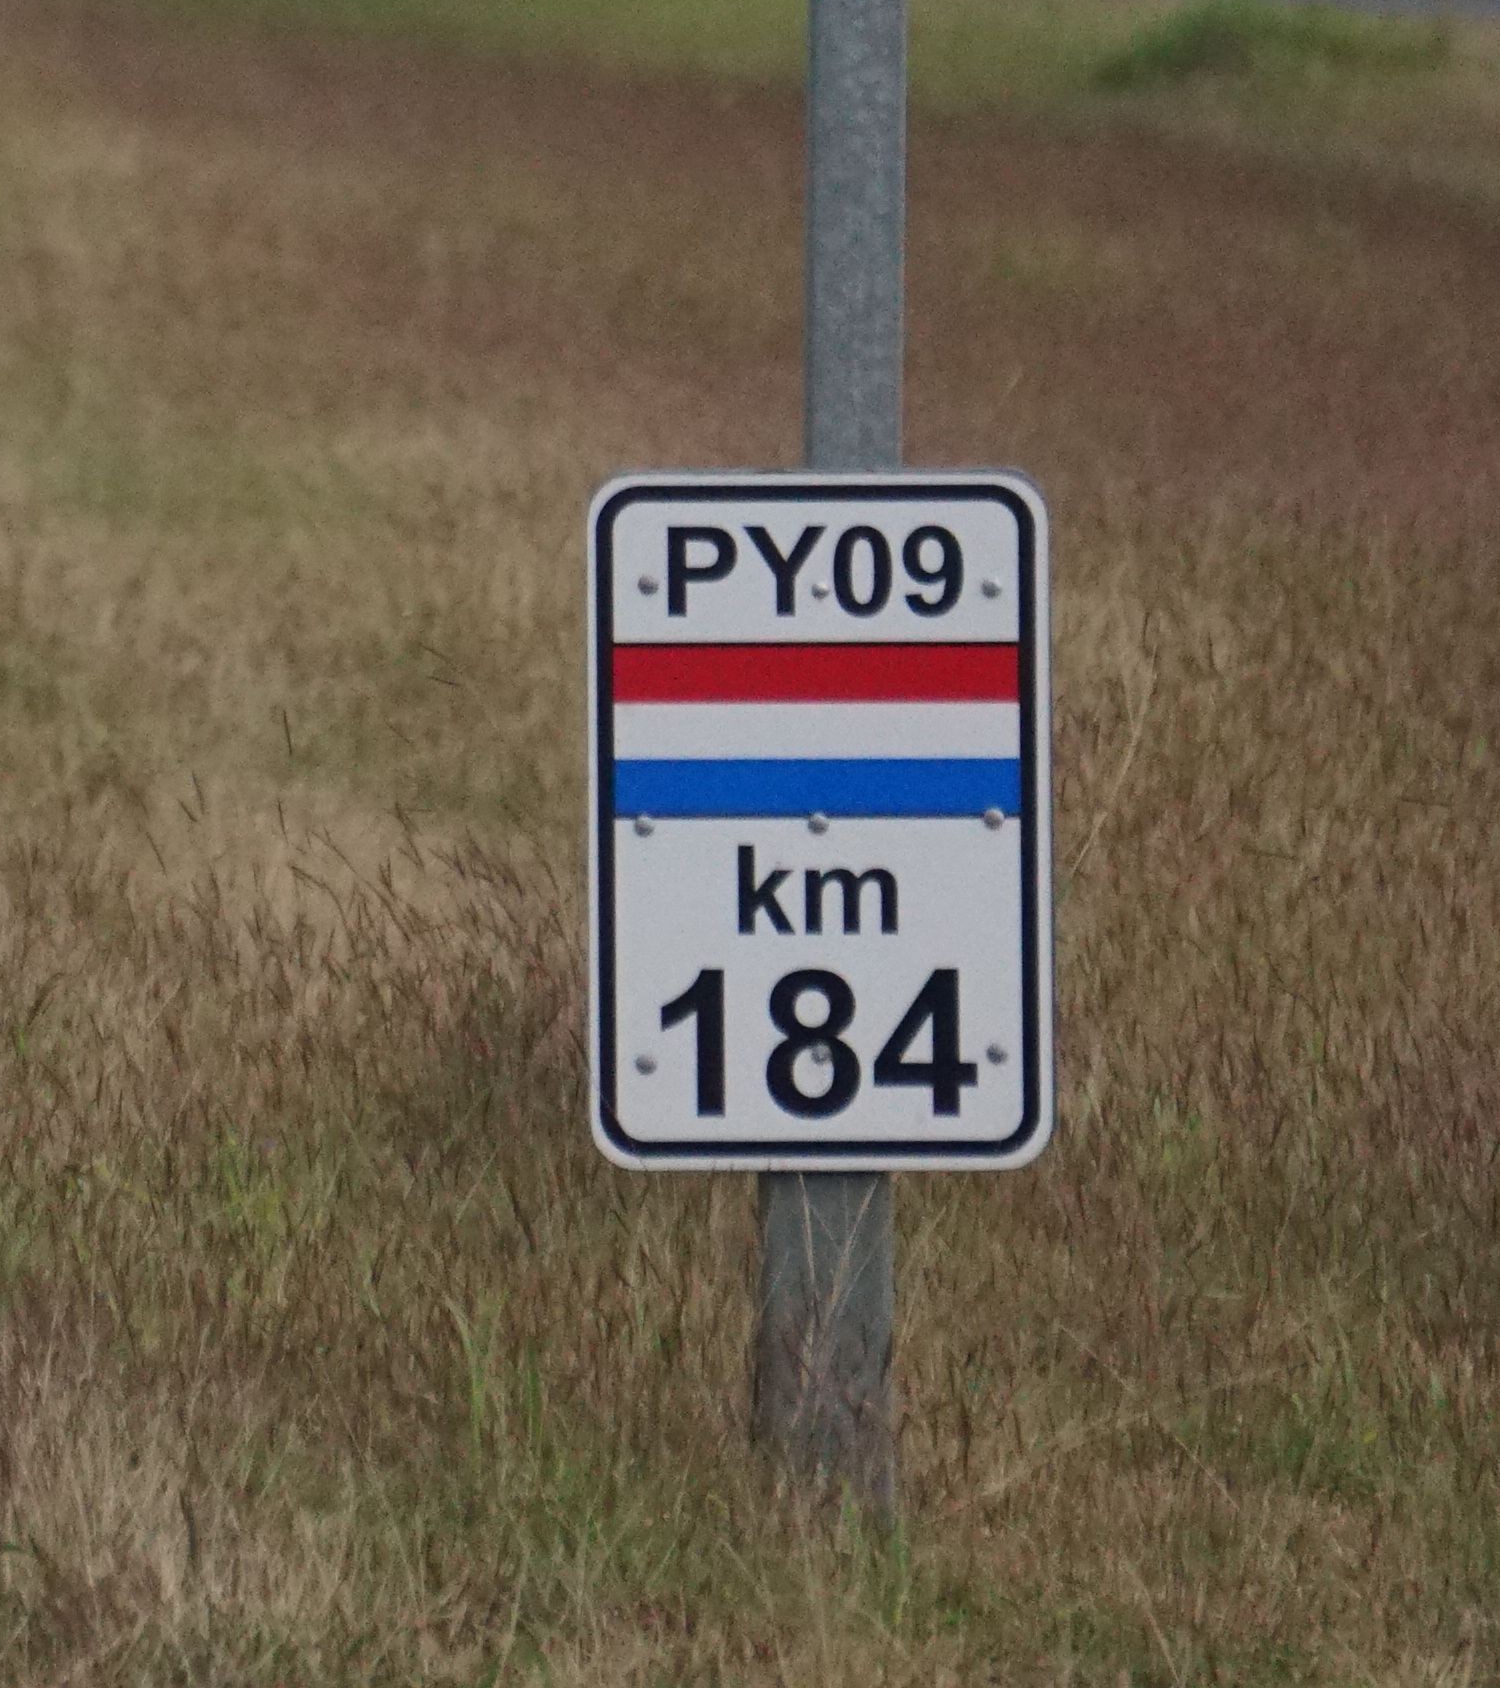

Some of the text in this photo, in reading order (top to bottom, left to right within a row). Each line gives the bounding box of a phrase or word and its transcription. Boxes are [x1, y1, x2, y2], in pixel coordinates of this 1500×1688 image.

[666, 524, 964, 618] PY09
[736, 844, 899, 935] km
[659, 967, 979, 1120] 184
